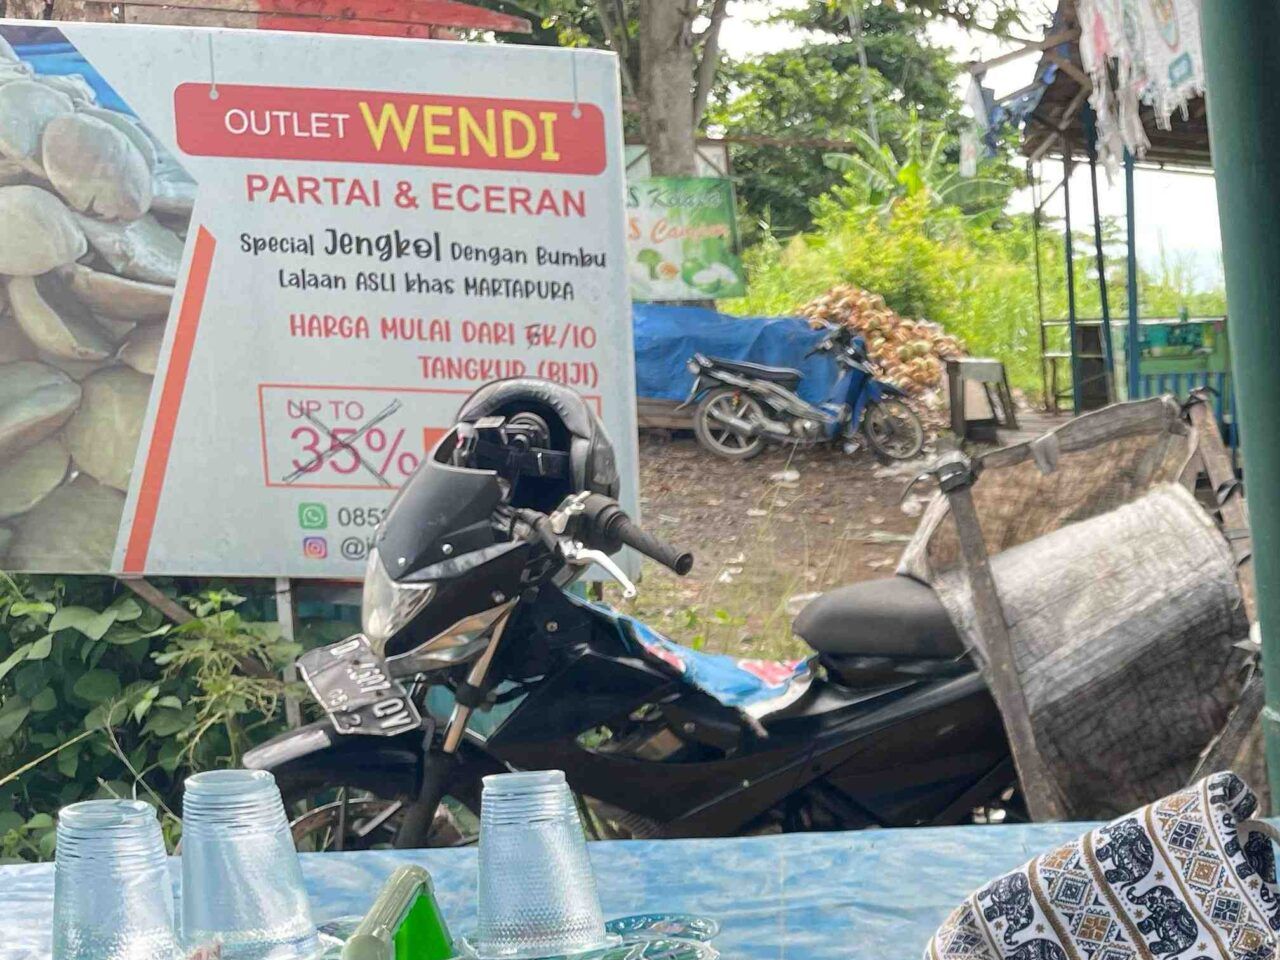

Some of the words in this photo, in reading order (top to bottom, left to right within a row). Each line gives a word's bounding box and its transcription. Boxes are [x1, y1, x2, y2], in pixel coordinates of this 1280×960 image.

[225, 108, 350, 139] OUTLET
[358, 101, 561, 162] WENDI
[246, 173, 380, 207] PARTAI
[394, 181, 419, 209] &
[431, 182, 587, 217] ECERAN
[240, 232, 315, 256] Special
[324, 228, 441, 262] Jengkol
[451, 243, 528, 267] Dengan
[537, 246, 607, 269] Bumbu
[278, 268, 346, 291] Lalaan
[355, 271, 396, 293] ASLI
[464, 277, 575, 300] MARTAPURA
[289, 313, 370, 339] HARGA
[380, 317, 451, 342] MULAI
[462, 321, 515, 346] DARI
[287, 399, 322, 419] UP
[328, 400, 365, 420] TO
[291, 426, 419, 476] 35%
[337, 507, 387, 527] 085
